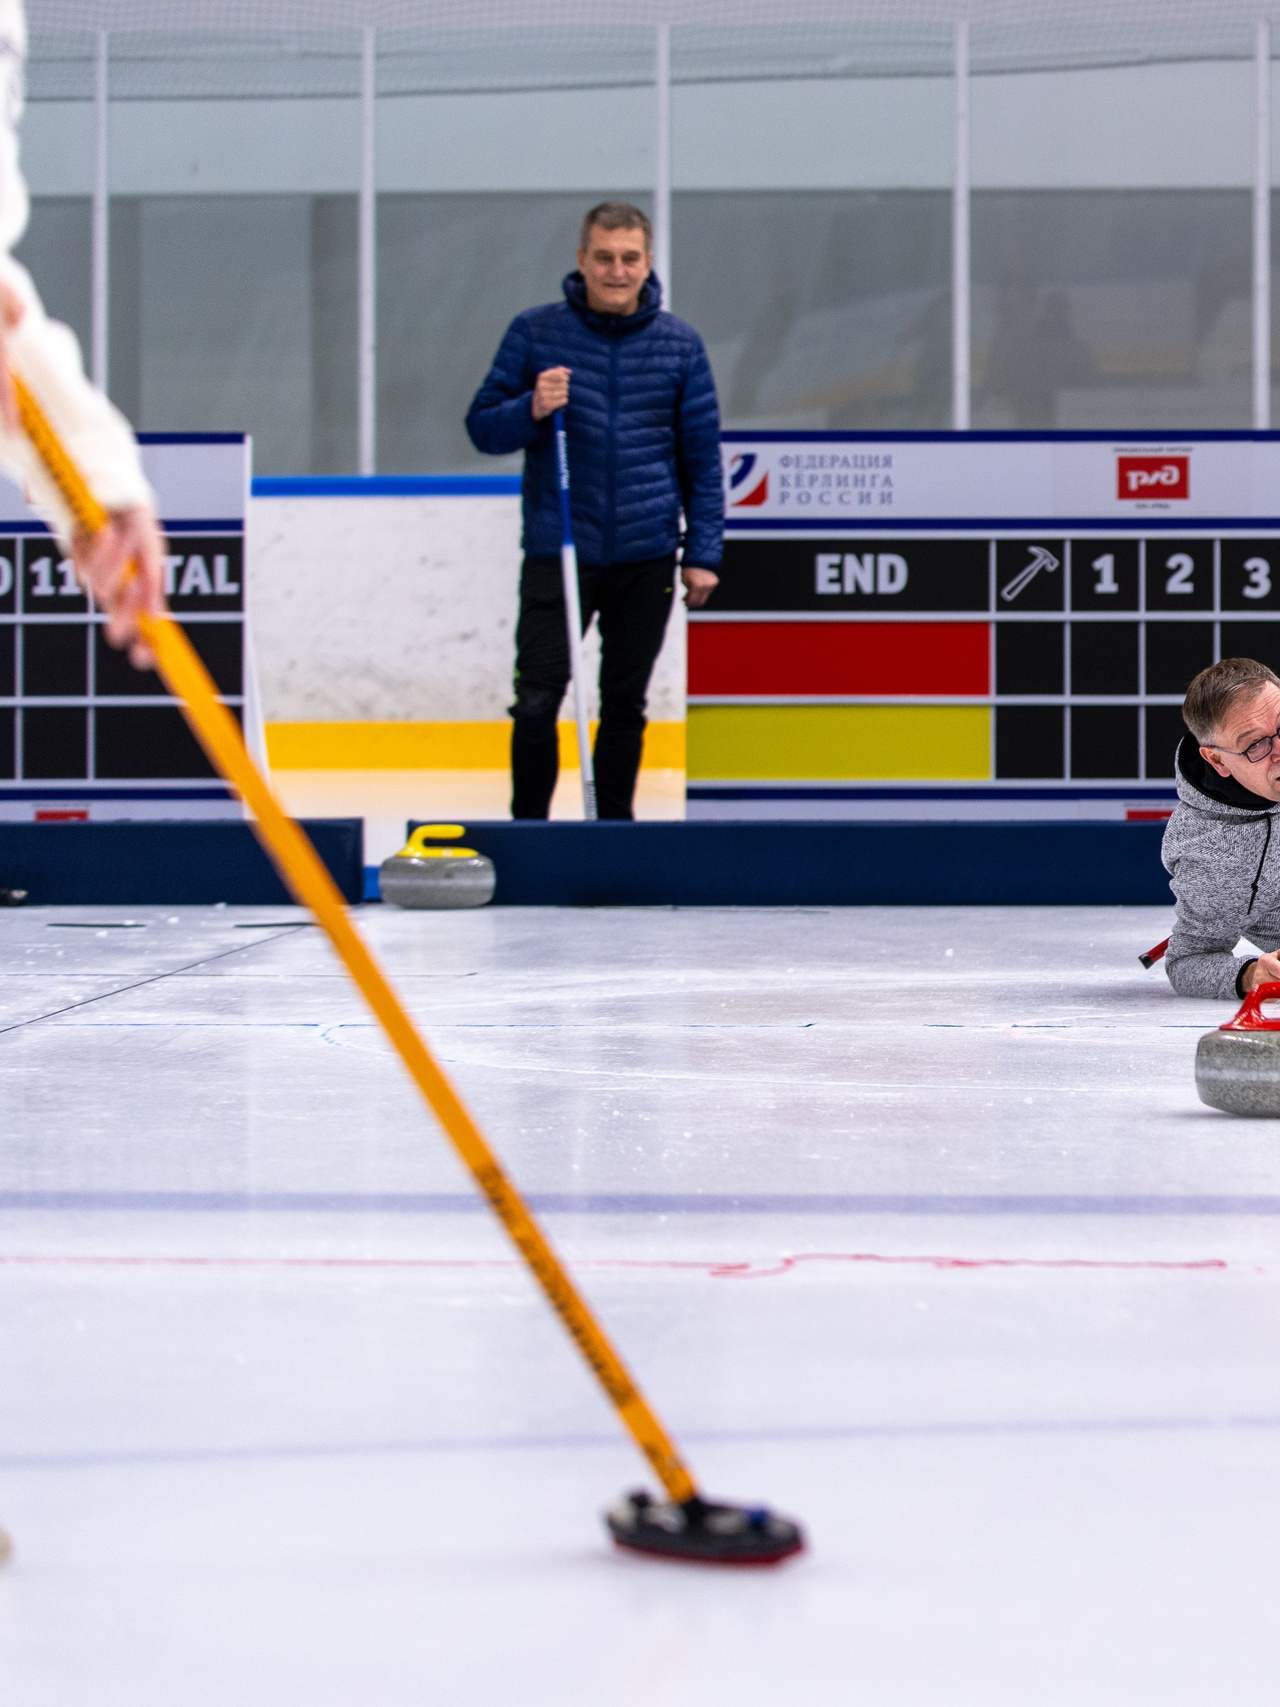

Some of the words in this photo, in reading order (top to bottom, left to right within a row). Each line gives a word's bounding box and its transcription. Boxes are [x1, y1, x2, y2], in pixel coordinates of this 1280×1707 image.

[778, 454, 893, 470] ФЕДЕРАЦИЯ
[778, 490, 893, 506] РОССИИ
[162, 554, 240, 595] TAL
[815, 553, 908, 595] END
[1092, 554, 1119, 594] 1
[1165, 553, 1194, 594] 2
[1243, 557, 1272, 598] 3
